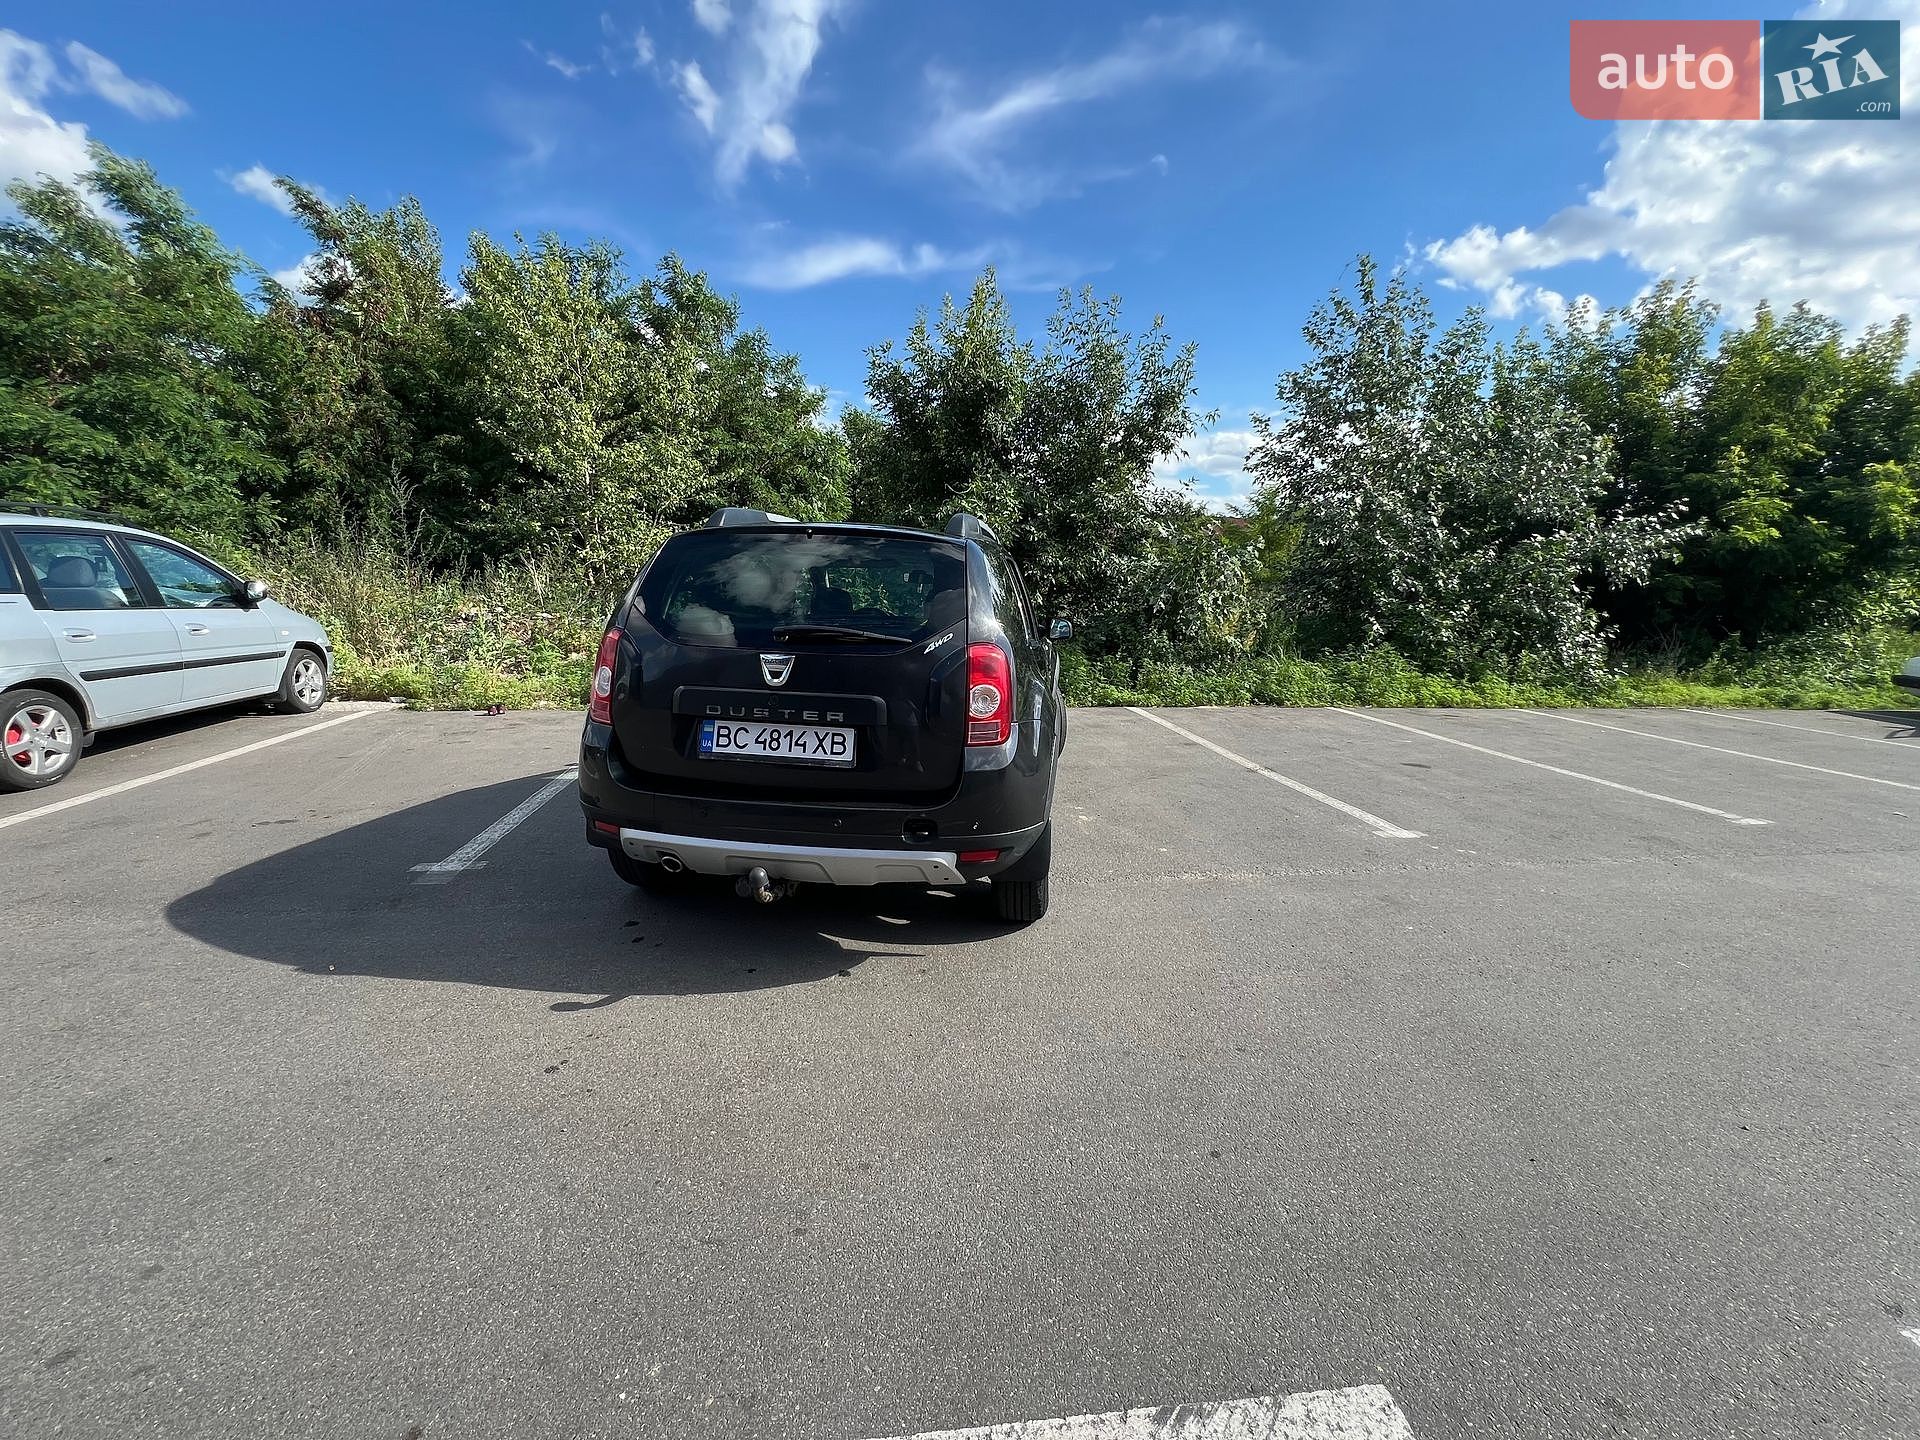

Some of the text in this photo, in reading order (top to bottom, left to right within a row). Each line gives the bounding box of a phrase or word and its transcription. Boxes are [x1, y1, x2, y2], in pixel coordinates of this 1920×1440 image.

[924, 633, 953, 654] 4WD
[706, 705, 844, 722] DUSTER
[702, 740, 712, 748] UA
[715, 725, 848, 756] BC 4814 XB
